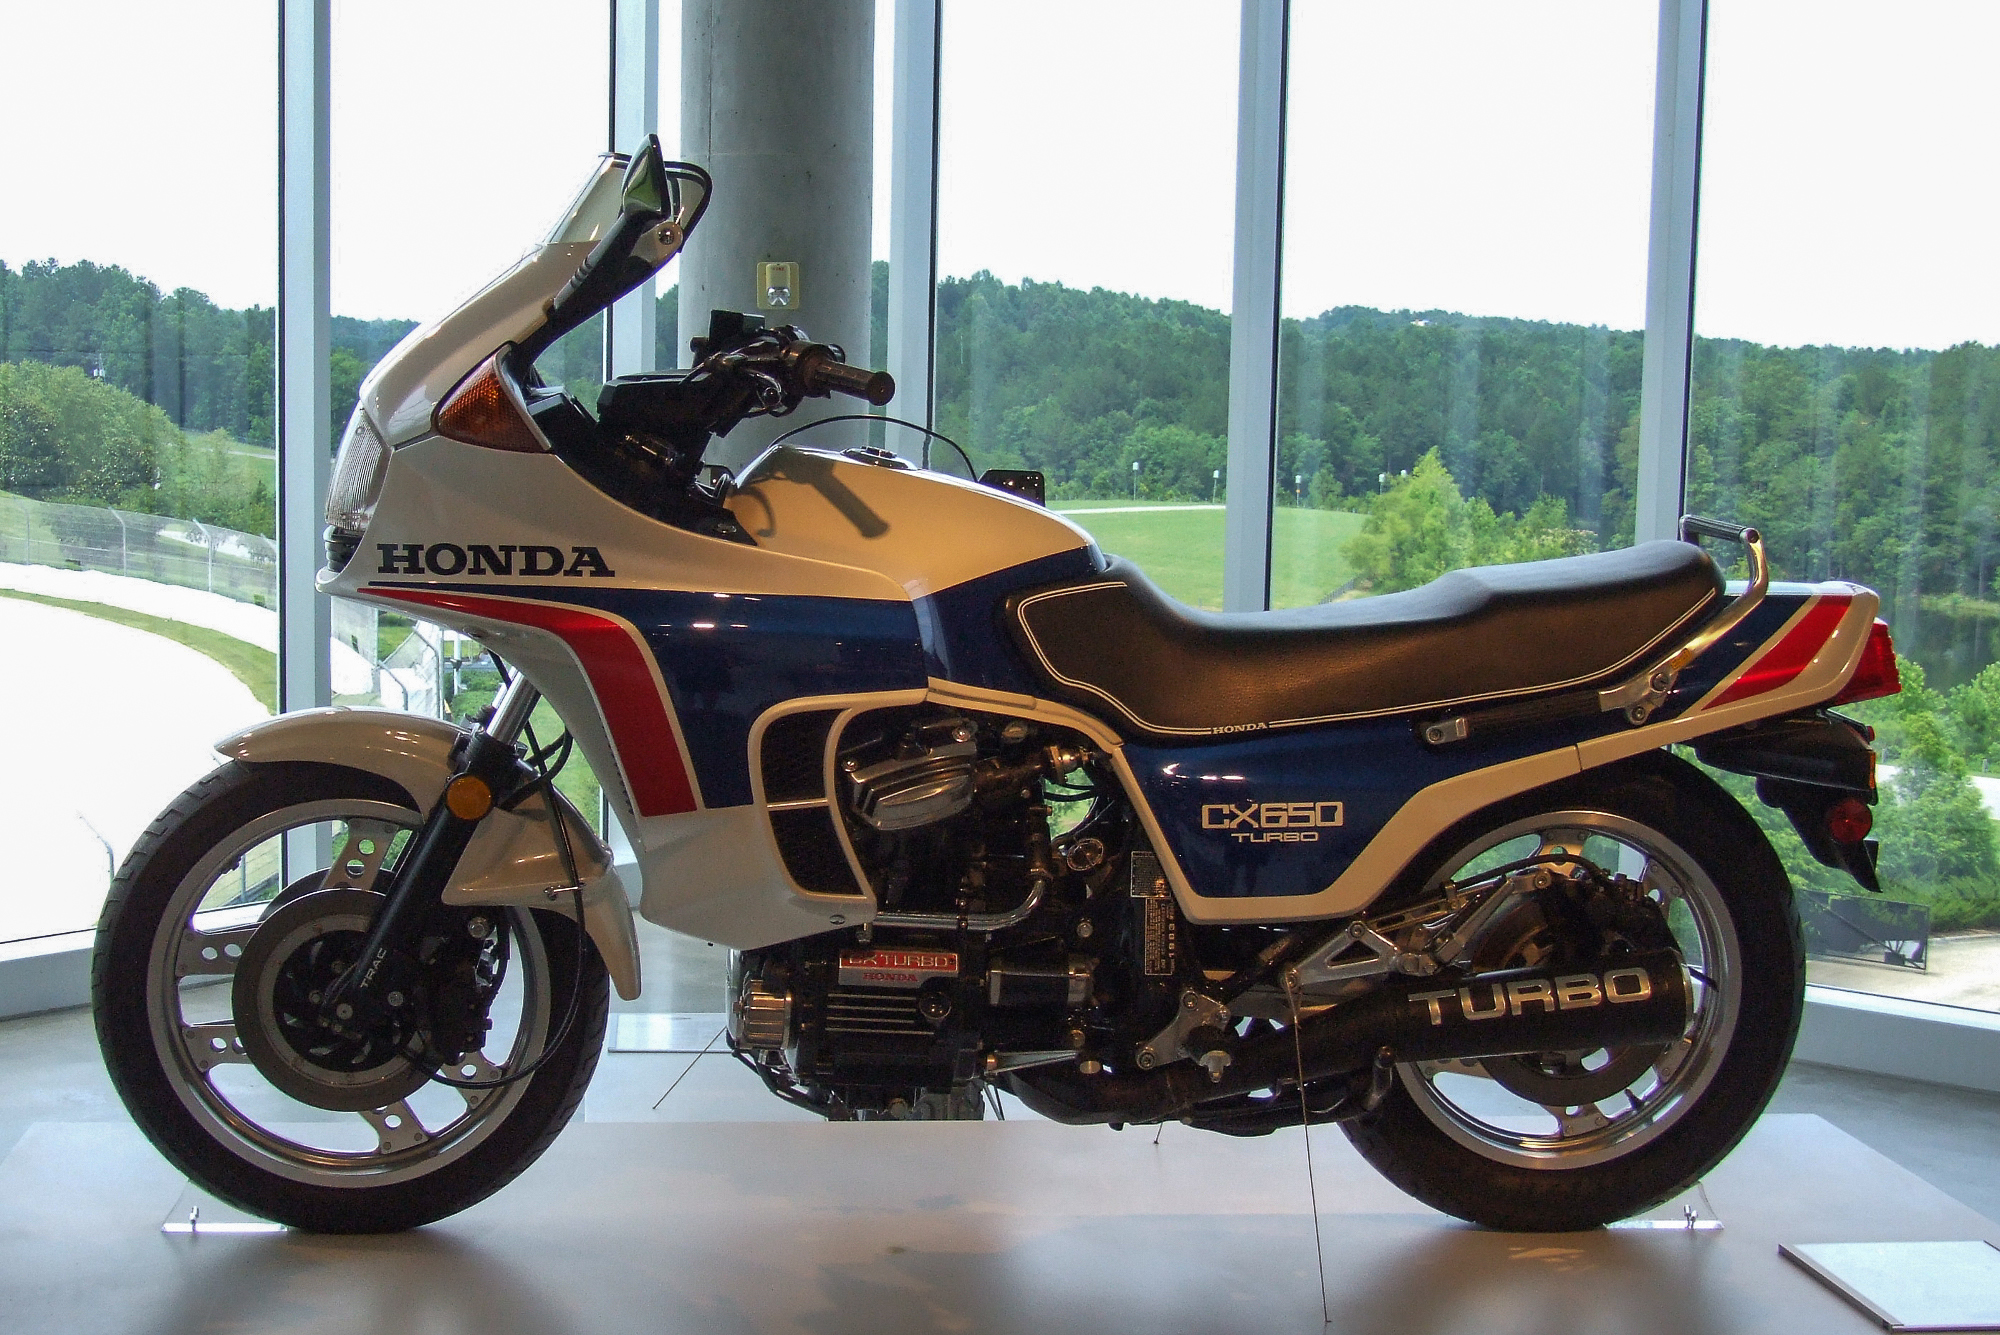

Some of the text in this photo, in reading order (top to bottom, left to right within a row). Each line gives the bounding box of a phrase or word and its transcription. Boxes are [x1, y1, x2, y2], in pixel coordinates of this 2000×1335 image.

[377, 543, 616, 577] HONDA
[1213, 722, 1268, 734] HONDA
[1202, 801, 1344, 829] CX650
[1231, 832, 1319, 843] TURBO
[360, 948, 387, 988] TRAC
[880, 953, 948, 967] TURBO
[862, 972, 918, 982] HONDA
[1408, 967, 1651, 1026] TURBO
